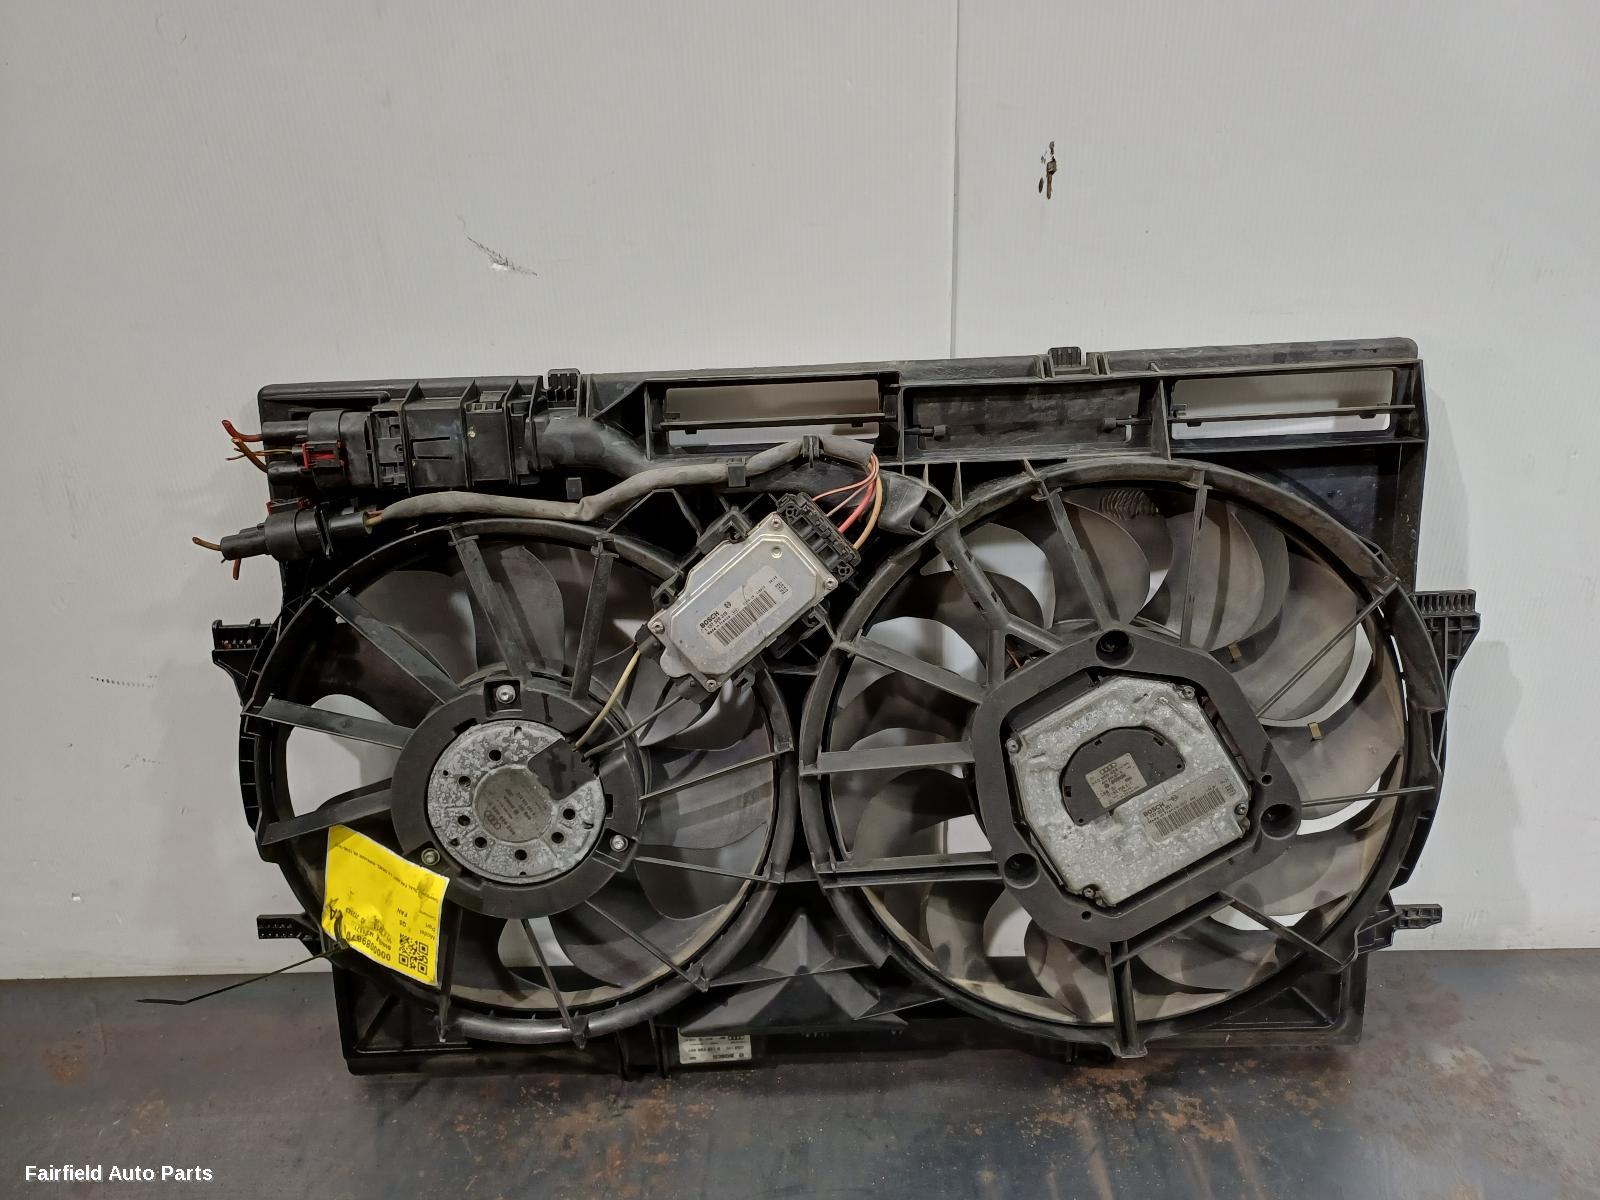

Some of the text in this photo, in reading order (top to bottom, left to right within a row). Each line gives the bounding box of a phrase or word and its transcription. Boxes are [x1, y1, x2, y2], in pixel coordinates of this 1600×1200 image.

[699, 610, 720, 629] BOSCH
[1142, 801, 1165, 817] BOSCH
[396, 908, 408, 917] FAN
